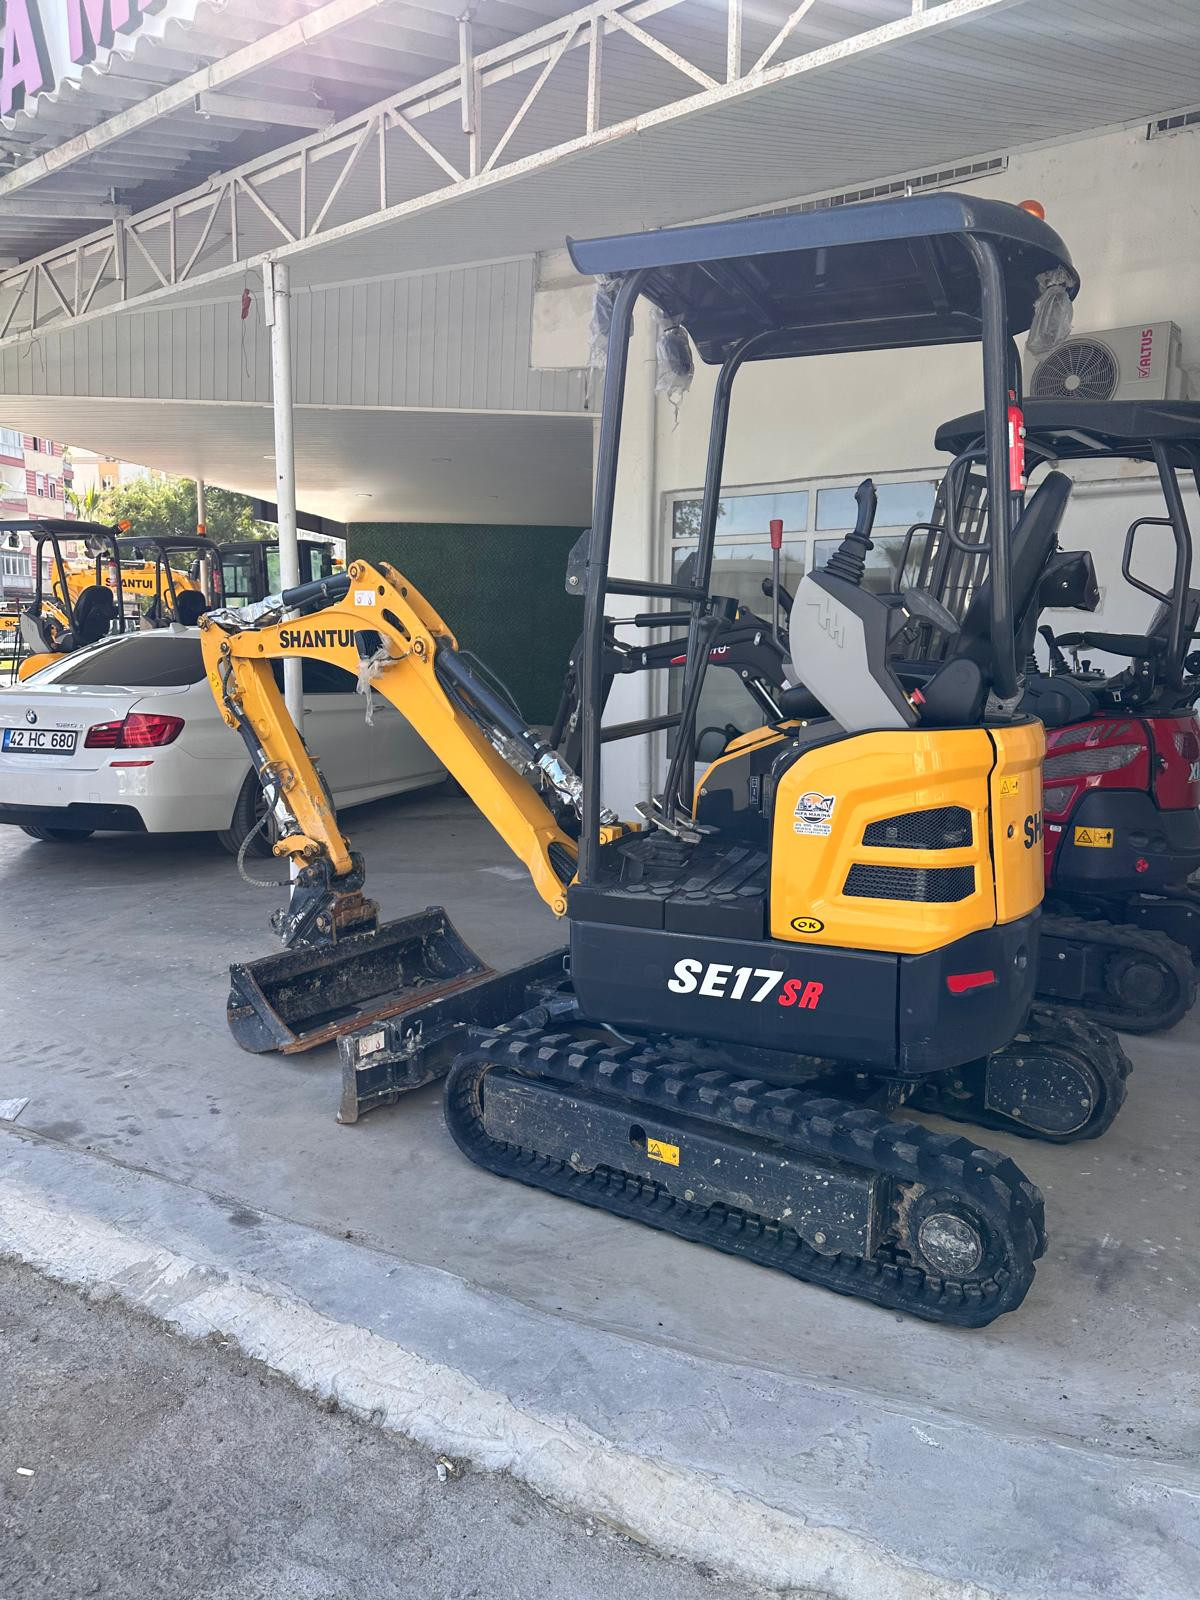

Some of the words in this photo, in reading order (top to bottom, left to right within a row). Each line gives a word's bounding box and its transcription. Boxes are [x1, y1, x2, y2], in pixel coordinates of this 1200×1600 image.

[105, 577, 153, 589] SANTUI
[279, 629, 355, 649] SHANTUI
[9, 731, 25, 746] 42
[28, 732, 46, 747] HC
[51, 733, 74, 748] 680
[797, 921, 817, 929] OK
